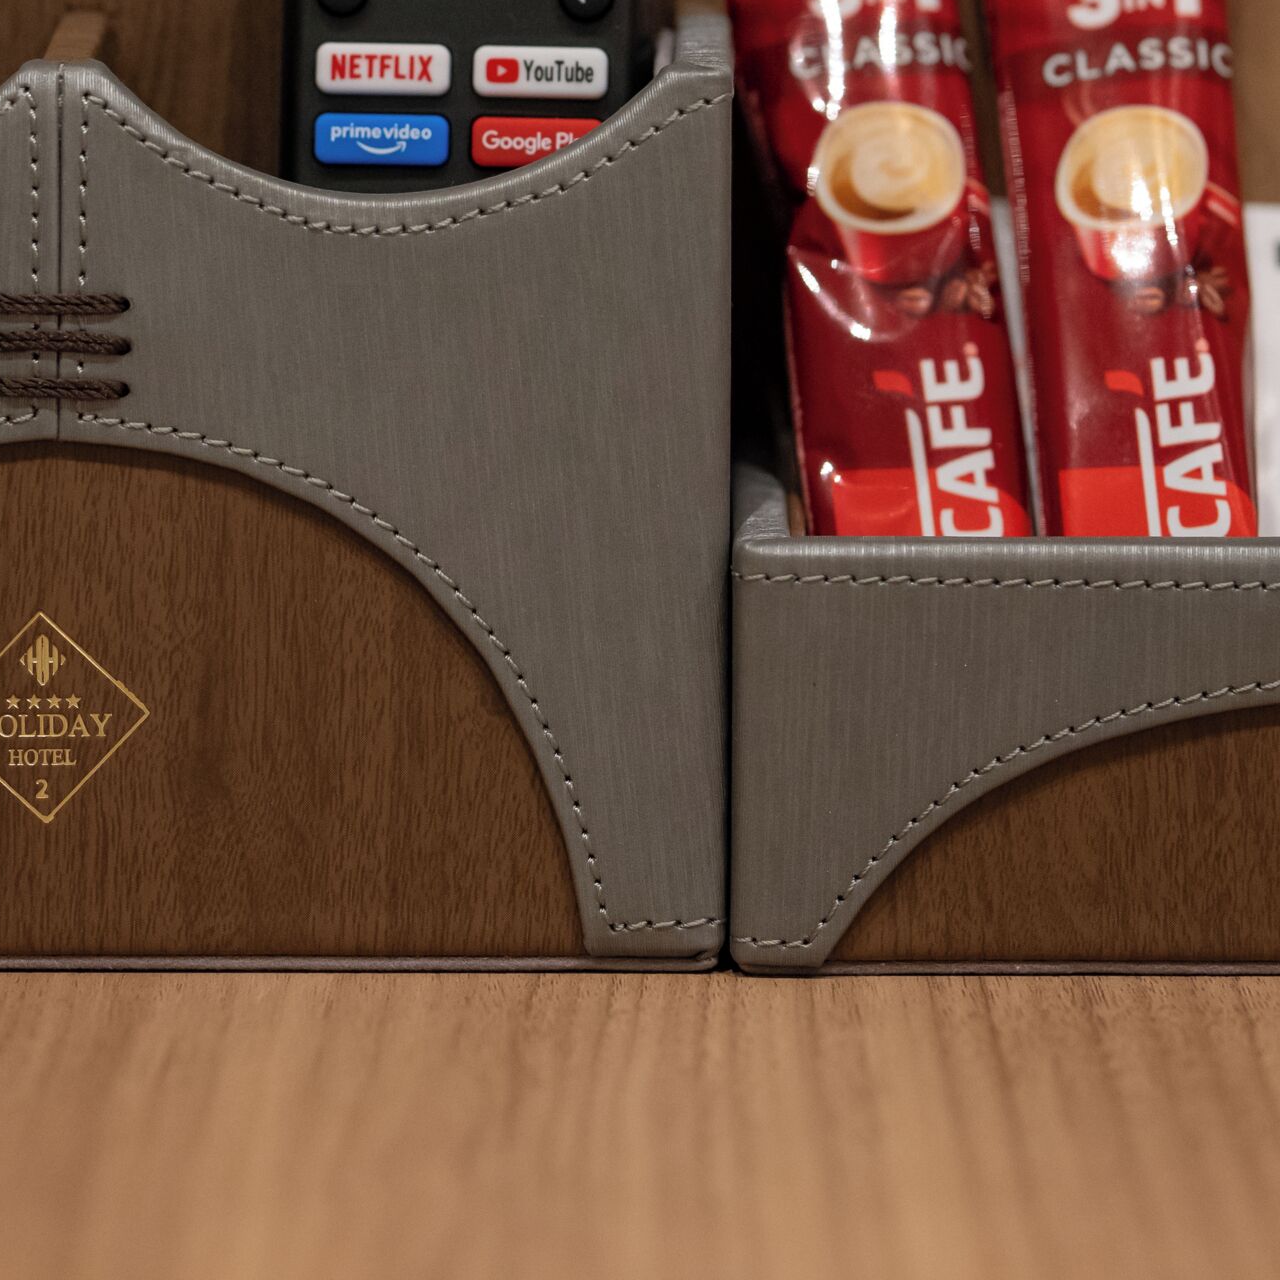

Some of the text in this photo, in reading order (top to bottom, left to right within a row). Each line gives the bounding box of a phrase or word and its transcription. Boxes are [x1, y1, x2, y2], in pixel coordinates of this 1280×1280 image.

[329, 53, 433, 83] NETFLIX
[523, 60, 595, 84] YouTube
[1041, 36, 1234, 88] CLASSIC
[481, 129, 580, 156] Google Pl
[8, 748, 77, 767] HOTEL
[35, 778, 49, 799] 2
